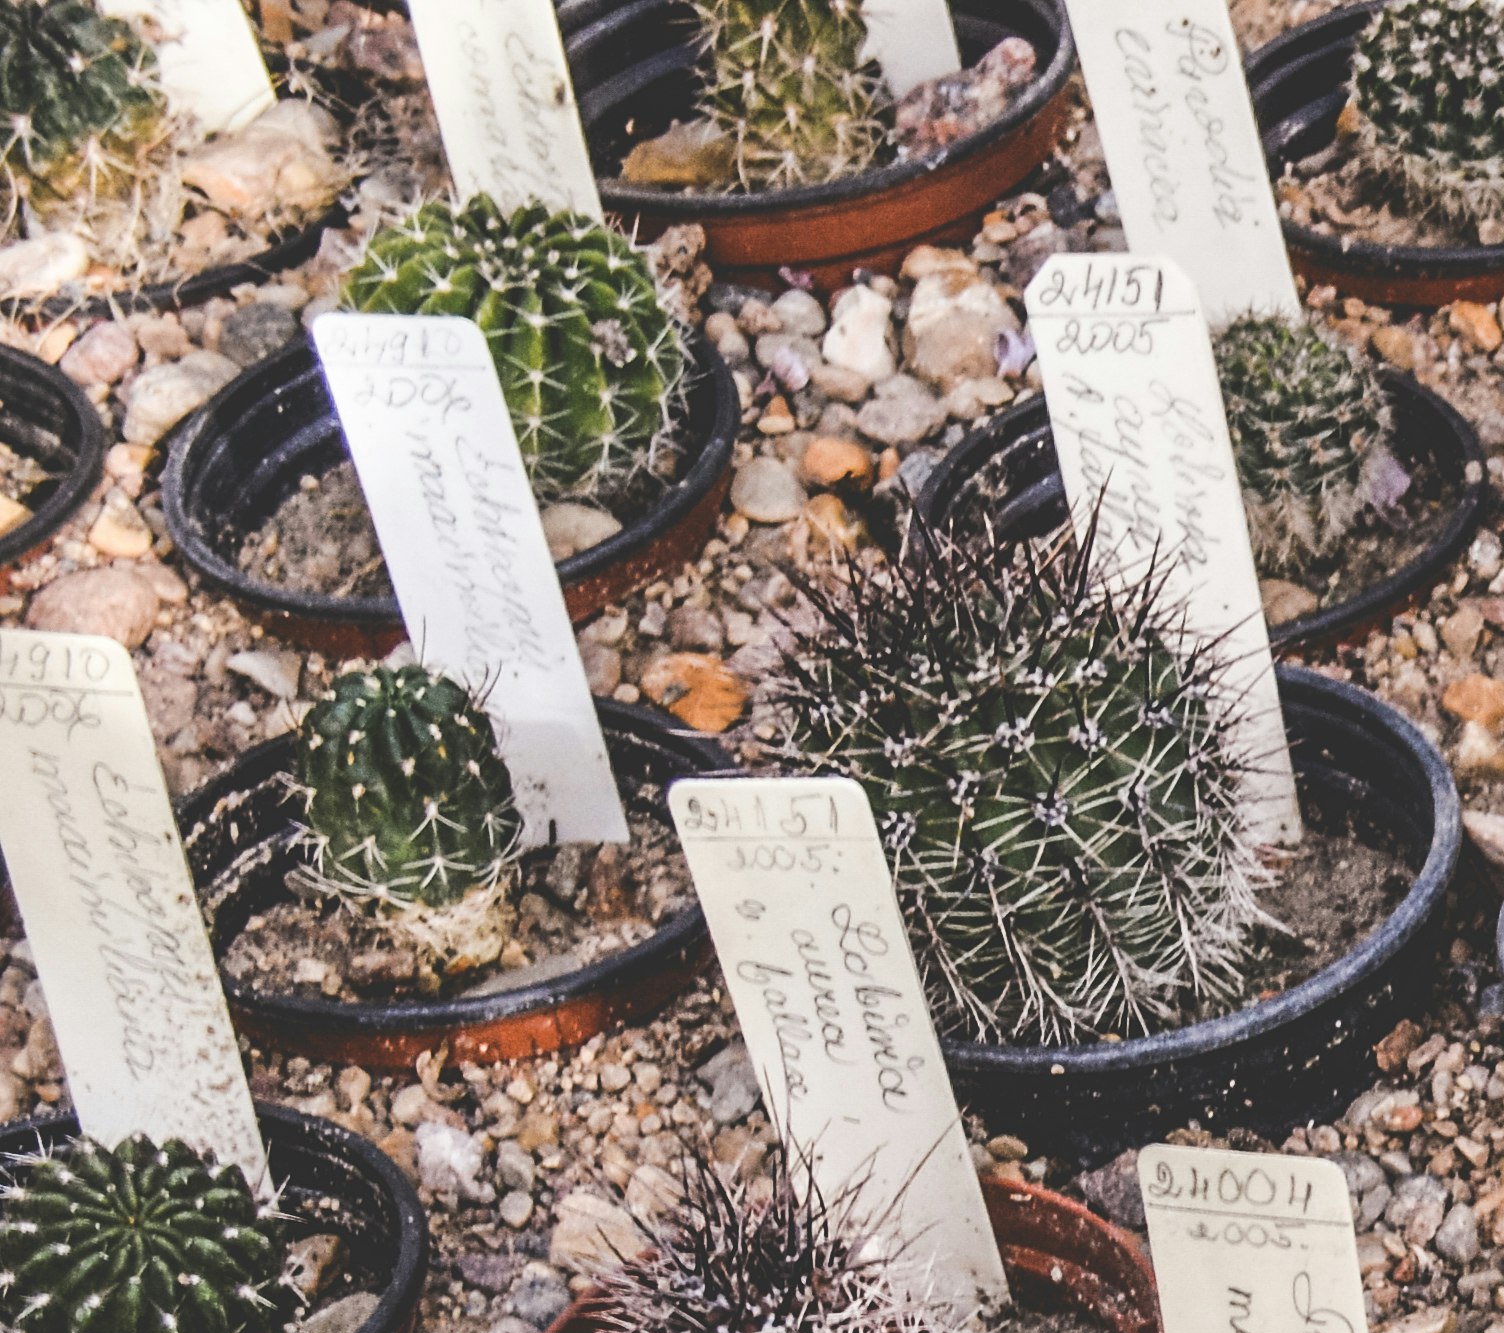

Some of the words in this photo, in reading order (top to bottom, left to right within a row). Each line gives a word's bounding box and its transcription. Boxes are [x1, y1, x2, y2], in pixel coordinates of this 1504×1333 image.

[1162, 17, 1262, 231] Parodia
[1027, 257, 1165, 315] 24151
[1045, 311, 1172, 356] 2005
[354, 373, 474, 424] 2006
[0, 642, 112, 684] 4910
[684, 791, 840, 838] 24151
[789, 929, 845, 1060] aurea
[828, 901, 927, 1111] Lobivia
[1145, 1159, 1315, 1215] 24004
